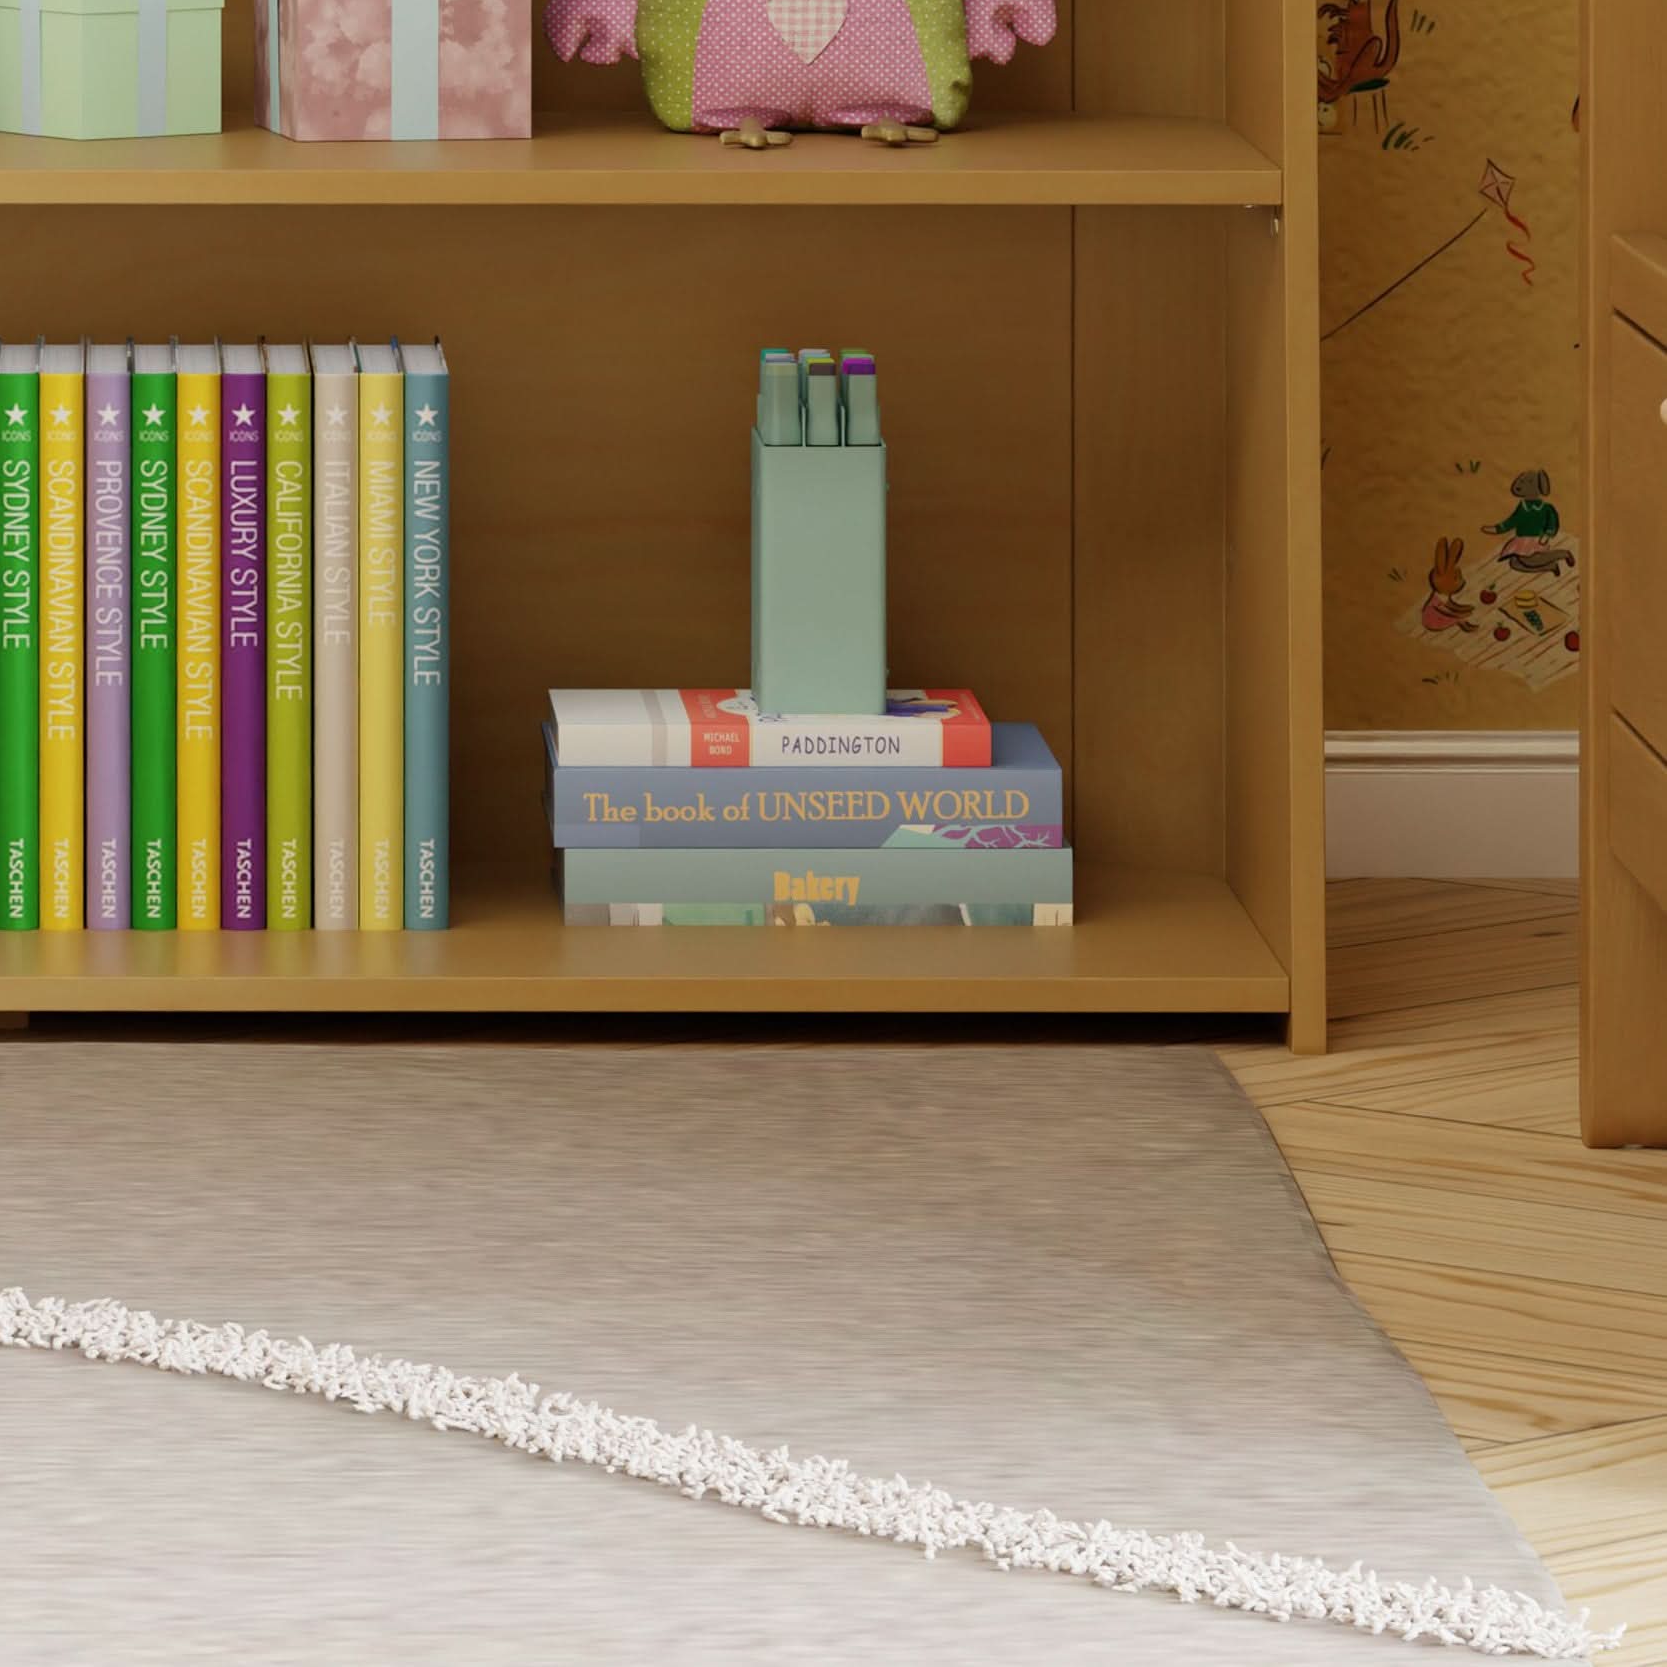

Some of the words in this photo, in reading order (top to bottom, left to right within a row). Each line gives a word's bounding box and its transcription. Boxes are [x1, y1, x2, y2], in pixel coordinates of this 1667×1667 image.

[2, 460, 31, 562] SYDNEY
[95, 461, 123, 598] PROVENCE
[140, 460, 168, 562] SYDNEY
[229, 460, 259, 560] LUXURY
[324, 461, 351, 558] ITALIAN
[367, 461, 396, 539] MIAMI
[413, 460, 441, 520] NEW
[47, 460, 76, 653] SCANDINAVIAN
[185, 460, 213, 653] SCANDINAVIAN
[275, 460, 303, 614] CALIFORNIA
[413, 528, 441, 599] YORK
[2, 570, 31, 649] STYLE
[140, 570, 168, 649] STYLE
[229, 568, 259, 647] STYLE
[324, 566, 351, 647] STYLE
[367, 546, 396, 627] STYLE
[95, 607, 123, 686] STYLE
[275, 621, 303, 701] STYLE
[413, 606, 441, 686] STYLE
[47, 661, 76, 740] STYLE
[185, 661, 213, 740] STYLE
[781, 735, 901, 755] PADDINGTON
[583, 792, 637, 822] The
[643, 792, 716, 822] book
[723, 791, 751, 822] of
[757, 791, 891, 822] UNSEED
[896, 789, 1031, 821] WORLD
[8, 837, 24, 919] TASCHEN
[53, 837, 70, 919] TASCHEN
[101, 837, 117, 919] TASCHEN
[146, 837, 162, 919] TASCHEN
[191, 837, 207, 919] TASCHEN
[236, 837, 252, 919] TASCHEN
[281, 837, 297, 919] TASCHEN
[330, 837, 345, 919] TASCHEN
[374, 837, 390, 919] TASCHEN
[419, 837, 435, 919] TASCHEN
[772, 870, 861, 908] Bakery
